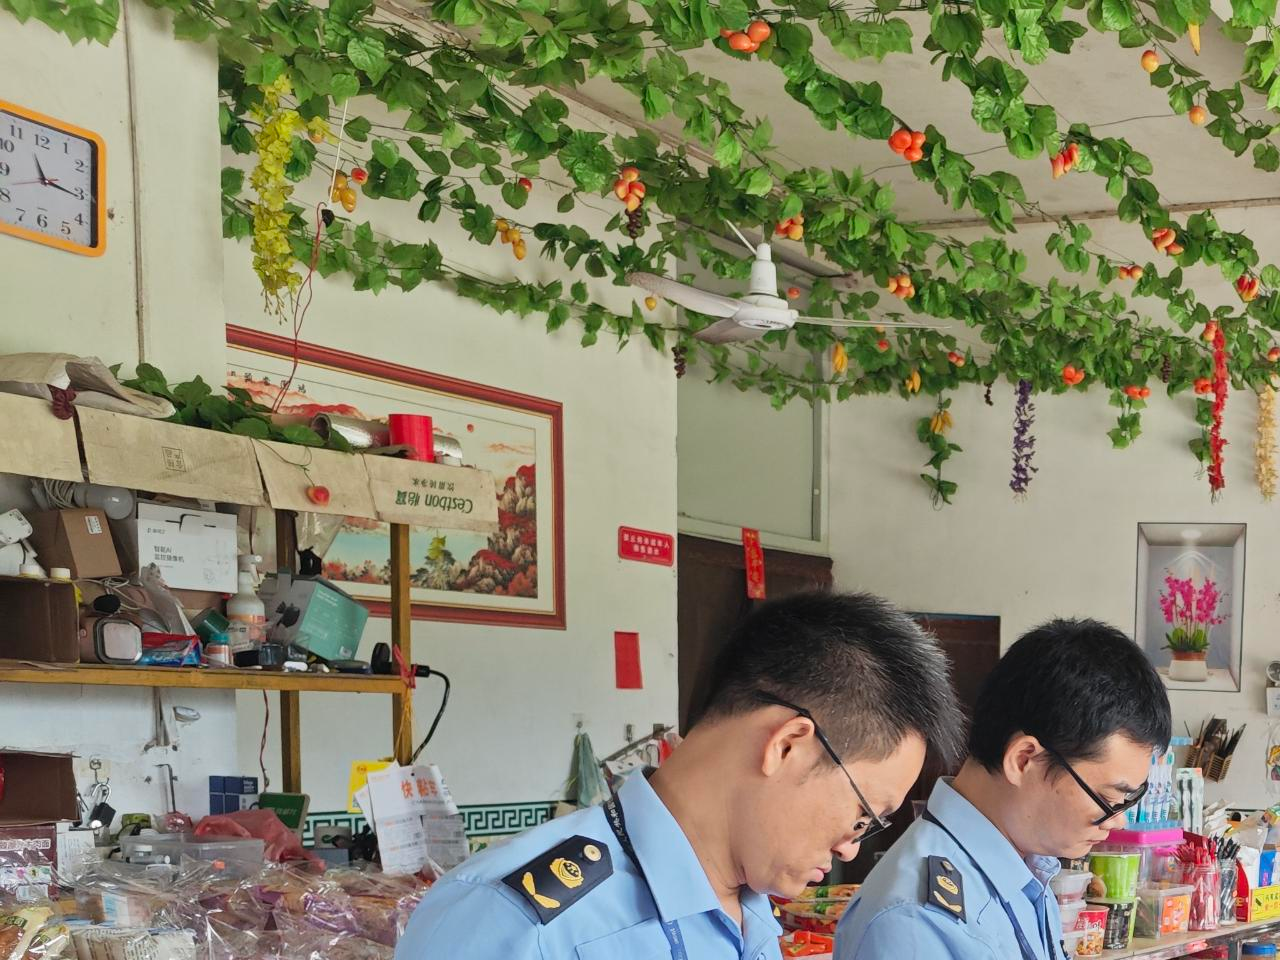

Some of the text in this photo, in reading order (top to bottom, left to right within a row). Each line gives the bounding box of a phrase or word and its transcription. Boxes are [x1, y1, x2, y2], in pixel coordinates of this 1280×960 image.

[10, 124, 23, 140] 11
[34, 133, 51, 150] 12
[62, 142, 70, 155] 1
[74, 159, 85, 173] 2
[15, 207, 26, 222] 7
[74, 213, 84, 226] 4
[60, 220, 72, 236] 5
